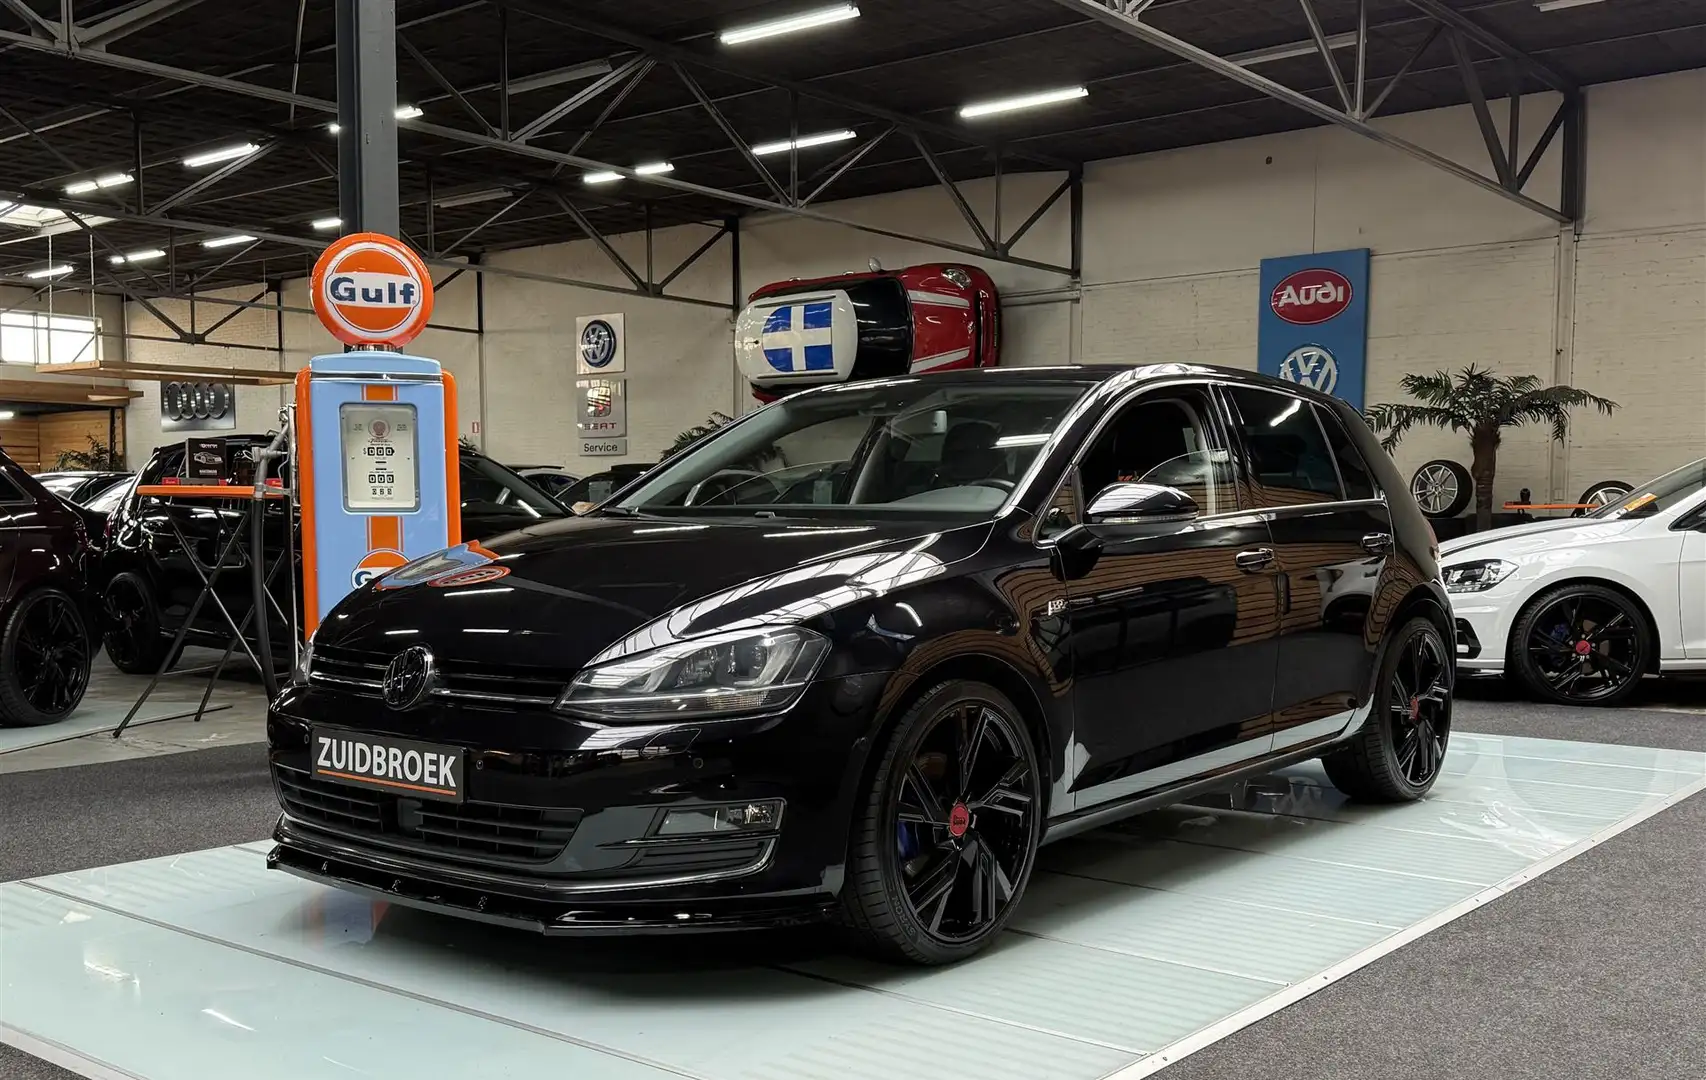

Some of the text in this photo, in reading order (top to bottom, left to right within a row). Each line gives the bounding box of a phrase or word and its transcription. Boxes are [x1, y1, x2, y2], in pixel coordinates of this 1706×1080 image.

[329, 276, 415, 304] Gulf
[584, 422, 617, 430] SEAT
[583, 441, 618, 452] Service
[317, 736, 457, 788] ZUIDBROEK
